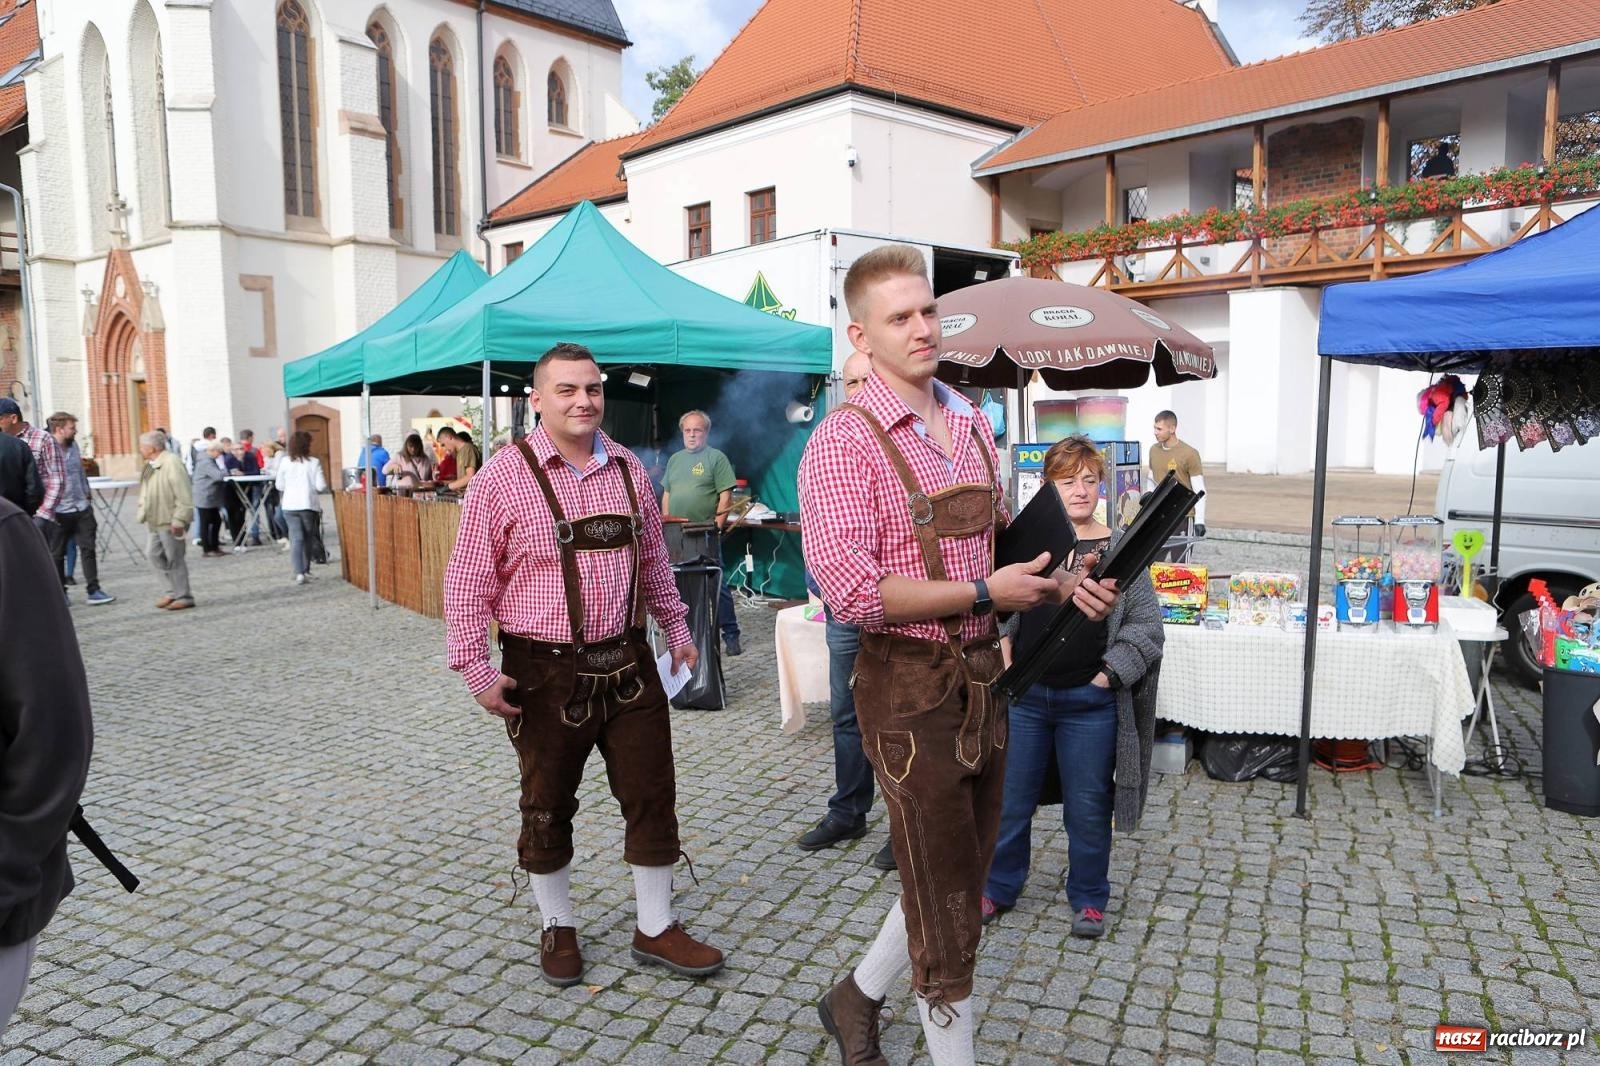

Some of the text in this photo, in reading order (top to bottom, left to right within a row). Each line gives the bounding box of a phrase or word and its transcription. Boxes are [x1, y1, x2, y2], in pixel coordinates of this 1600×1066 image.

[1018, 349, 1054, 363] LODY
[1058, 346, 1084, 363] JAK
[1019, 450, 1046, 463] PO
